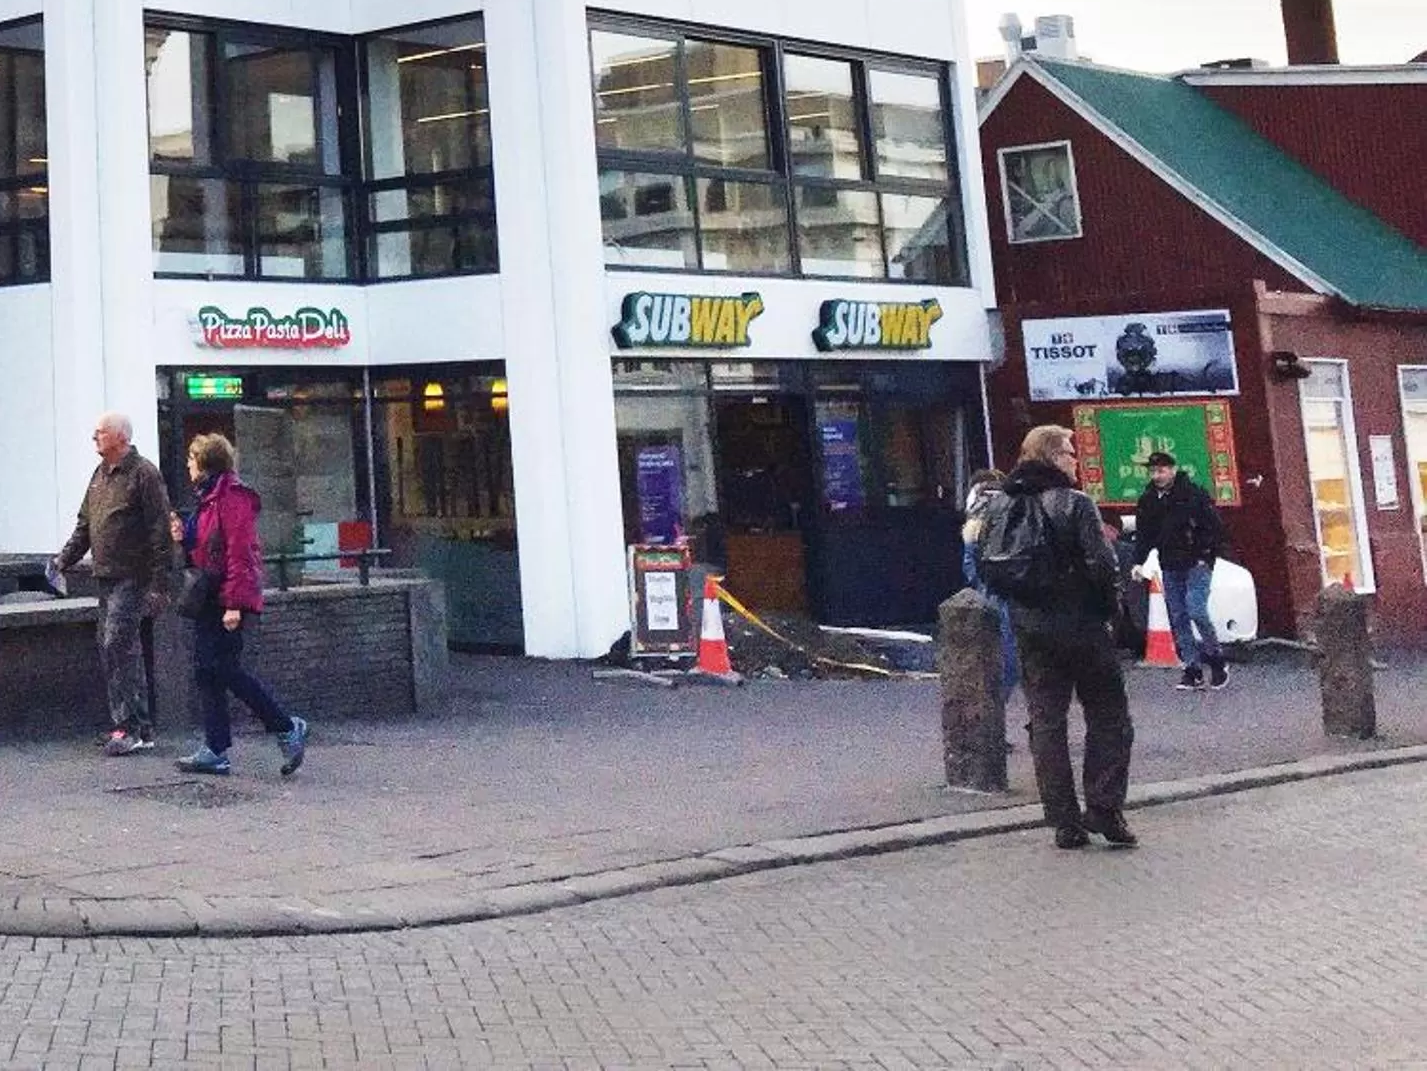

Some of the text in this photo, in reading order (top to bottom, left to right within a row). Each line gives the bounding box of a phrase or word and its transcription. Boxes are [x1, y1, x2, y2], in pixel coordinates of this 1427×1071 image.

[201, 309, 347, 342] Pizza Pasta Deli
[627, 293, 764, 343] SUBWAY
[825, 301, 944, 346] SUBWAY
[1030, 345, 1097, 360] TISSOT
